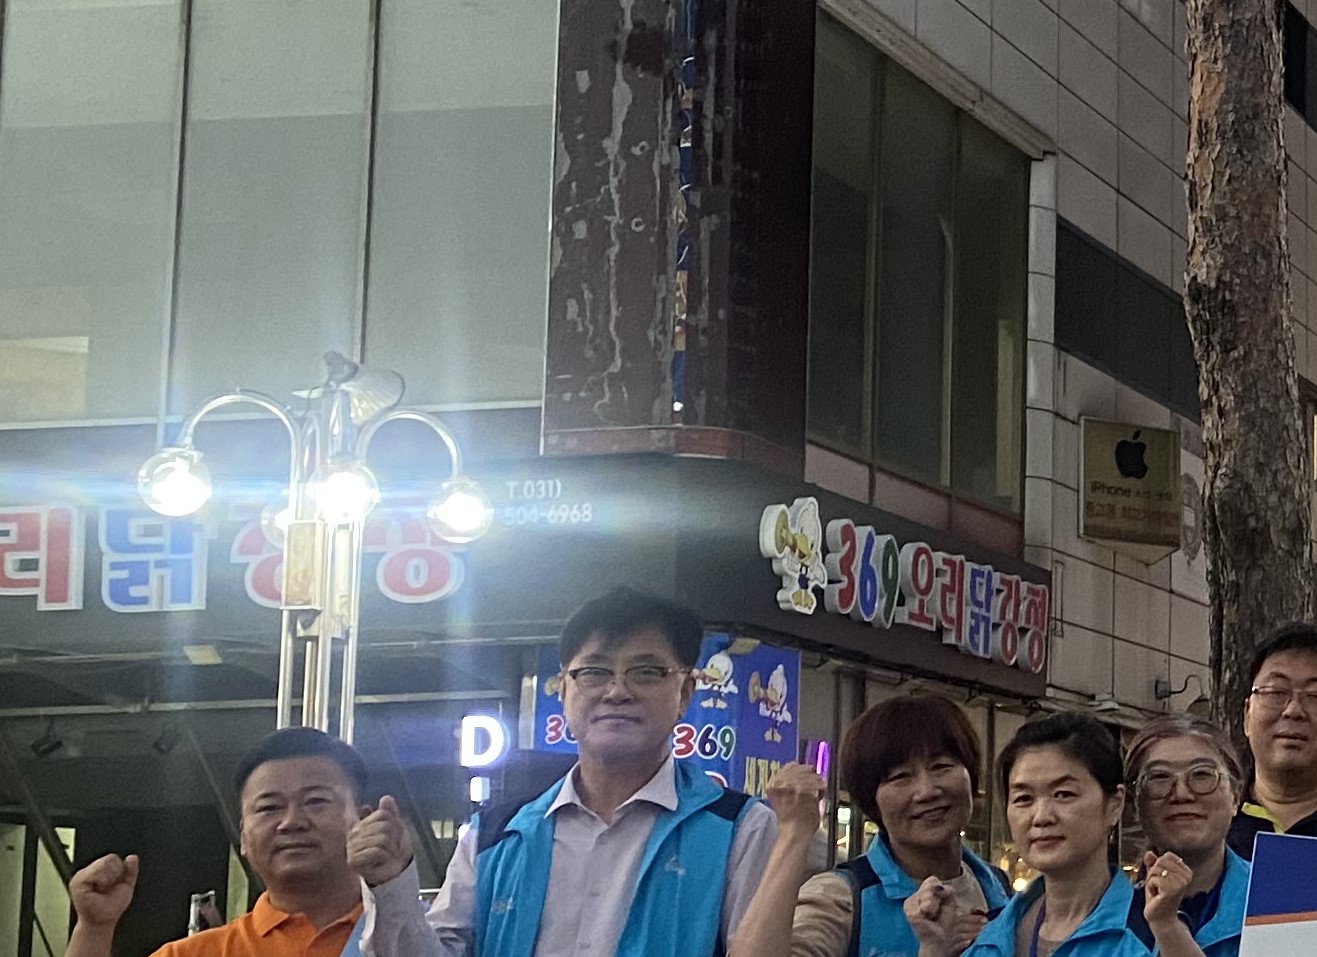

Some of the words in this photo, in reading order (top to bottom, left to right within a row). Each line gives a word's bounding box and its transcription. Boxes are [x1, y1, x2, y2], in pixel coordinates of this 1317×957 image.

[824, 519, 899, 630] 369
[900, 542, 1048, 674] 오리닭강정
[672, 723, 736, 759] 369
